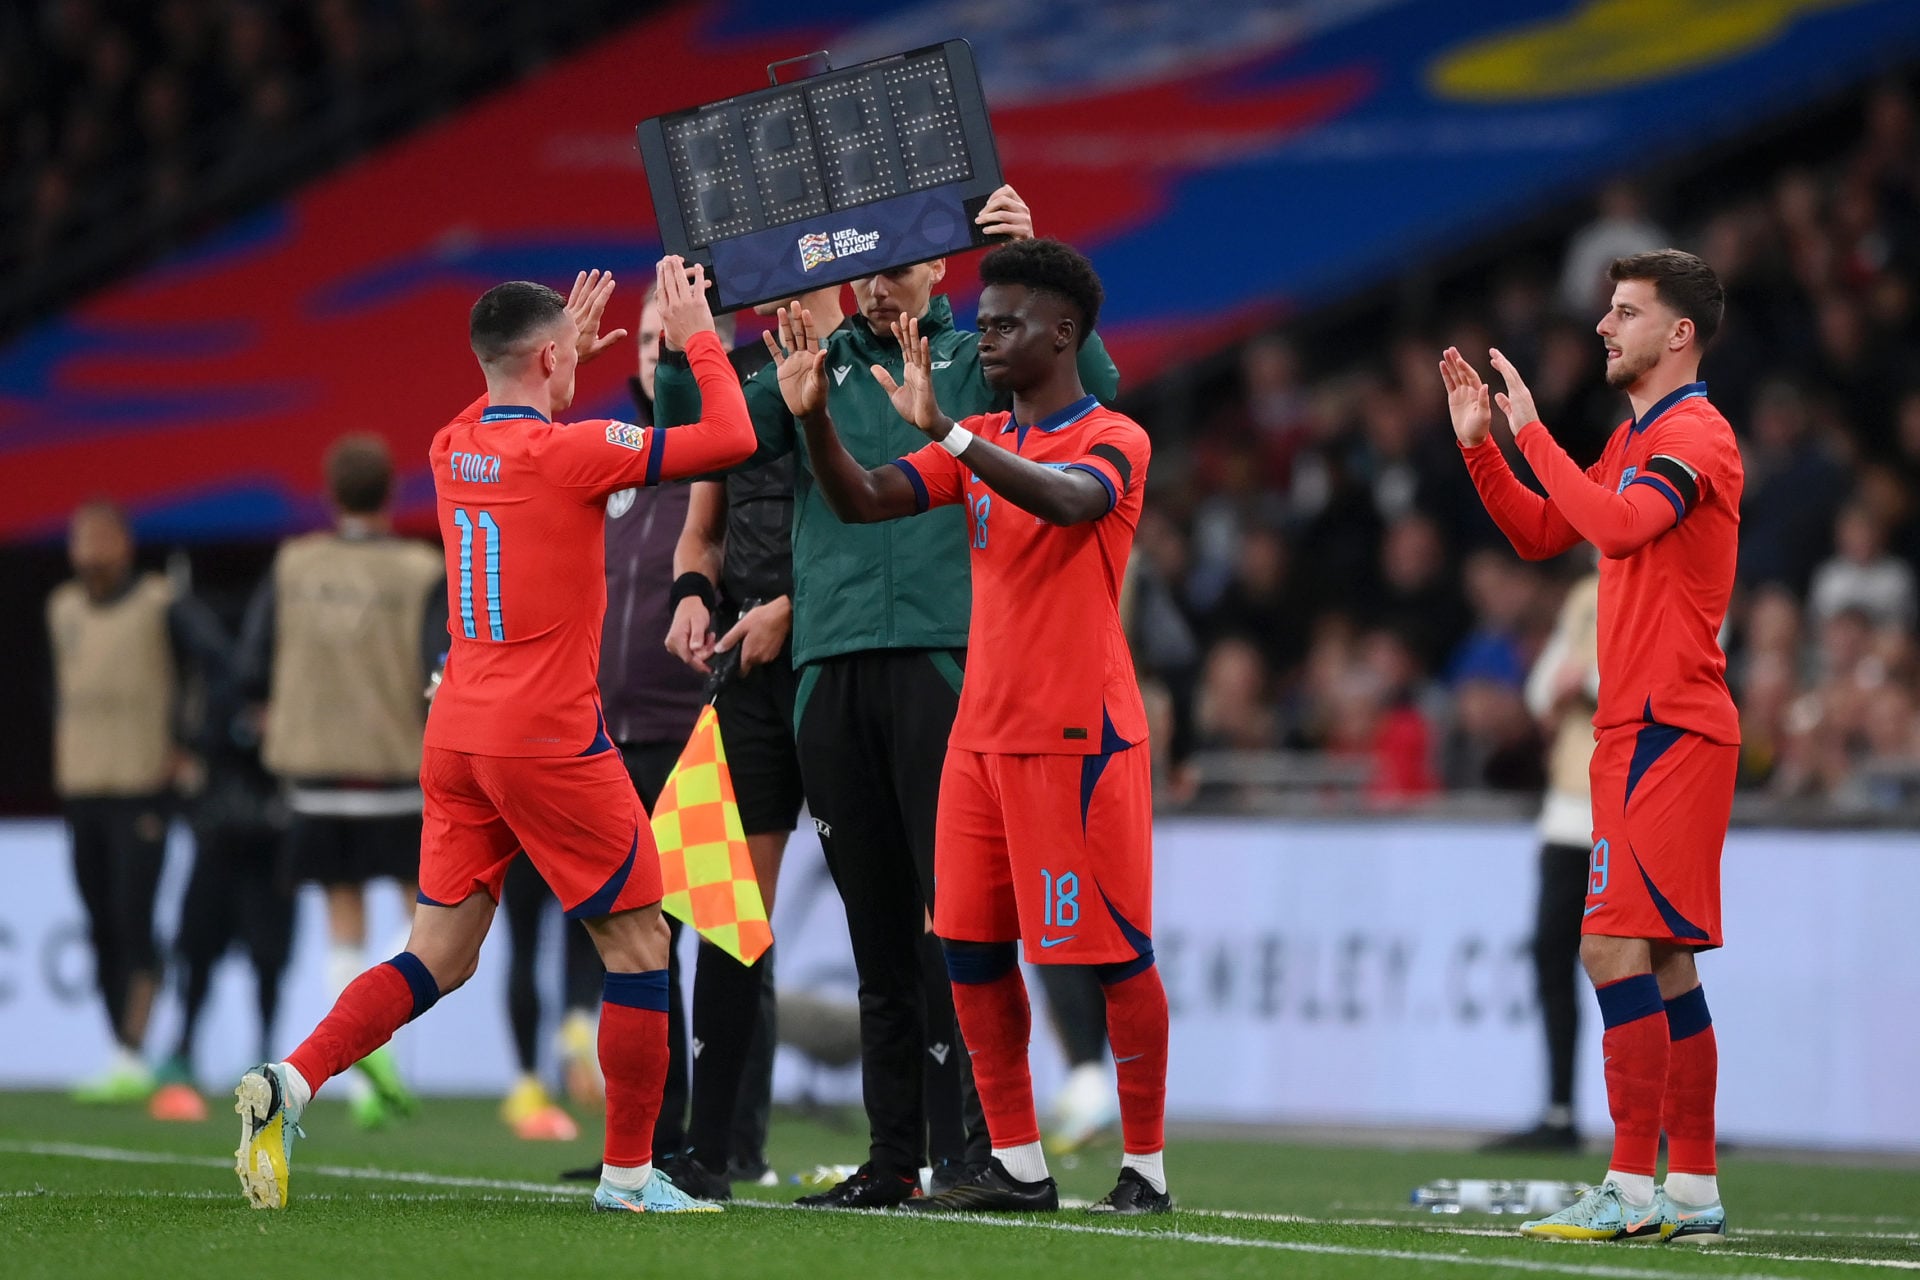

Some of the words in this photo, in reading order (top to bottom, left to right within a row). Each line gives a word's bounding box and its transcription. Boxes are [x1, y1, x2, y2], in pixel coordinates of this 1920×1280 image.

[832, 228, 859, 241] UEFA
[834, 231, 880, 250] NATIONS
[836, 241, 876, 258] LEAGUE
[451, 451, 500, 483] FODEN
[967, 492, 991, 549] 18
[454, 508, 505, 641] 11
[1040, 868, 1080, 927] 18
